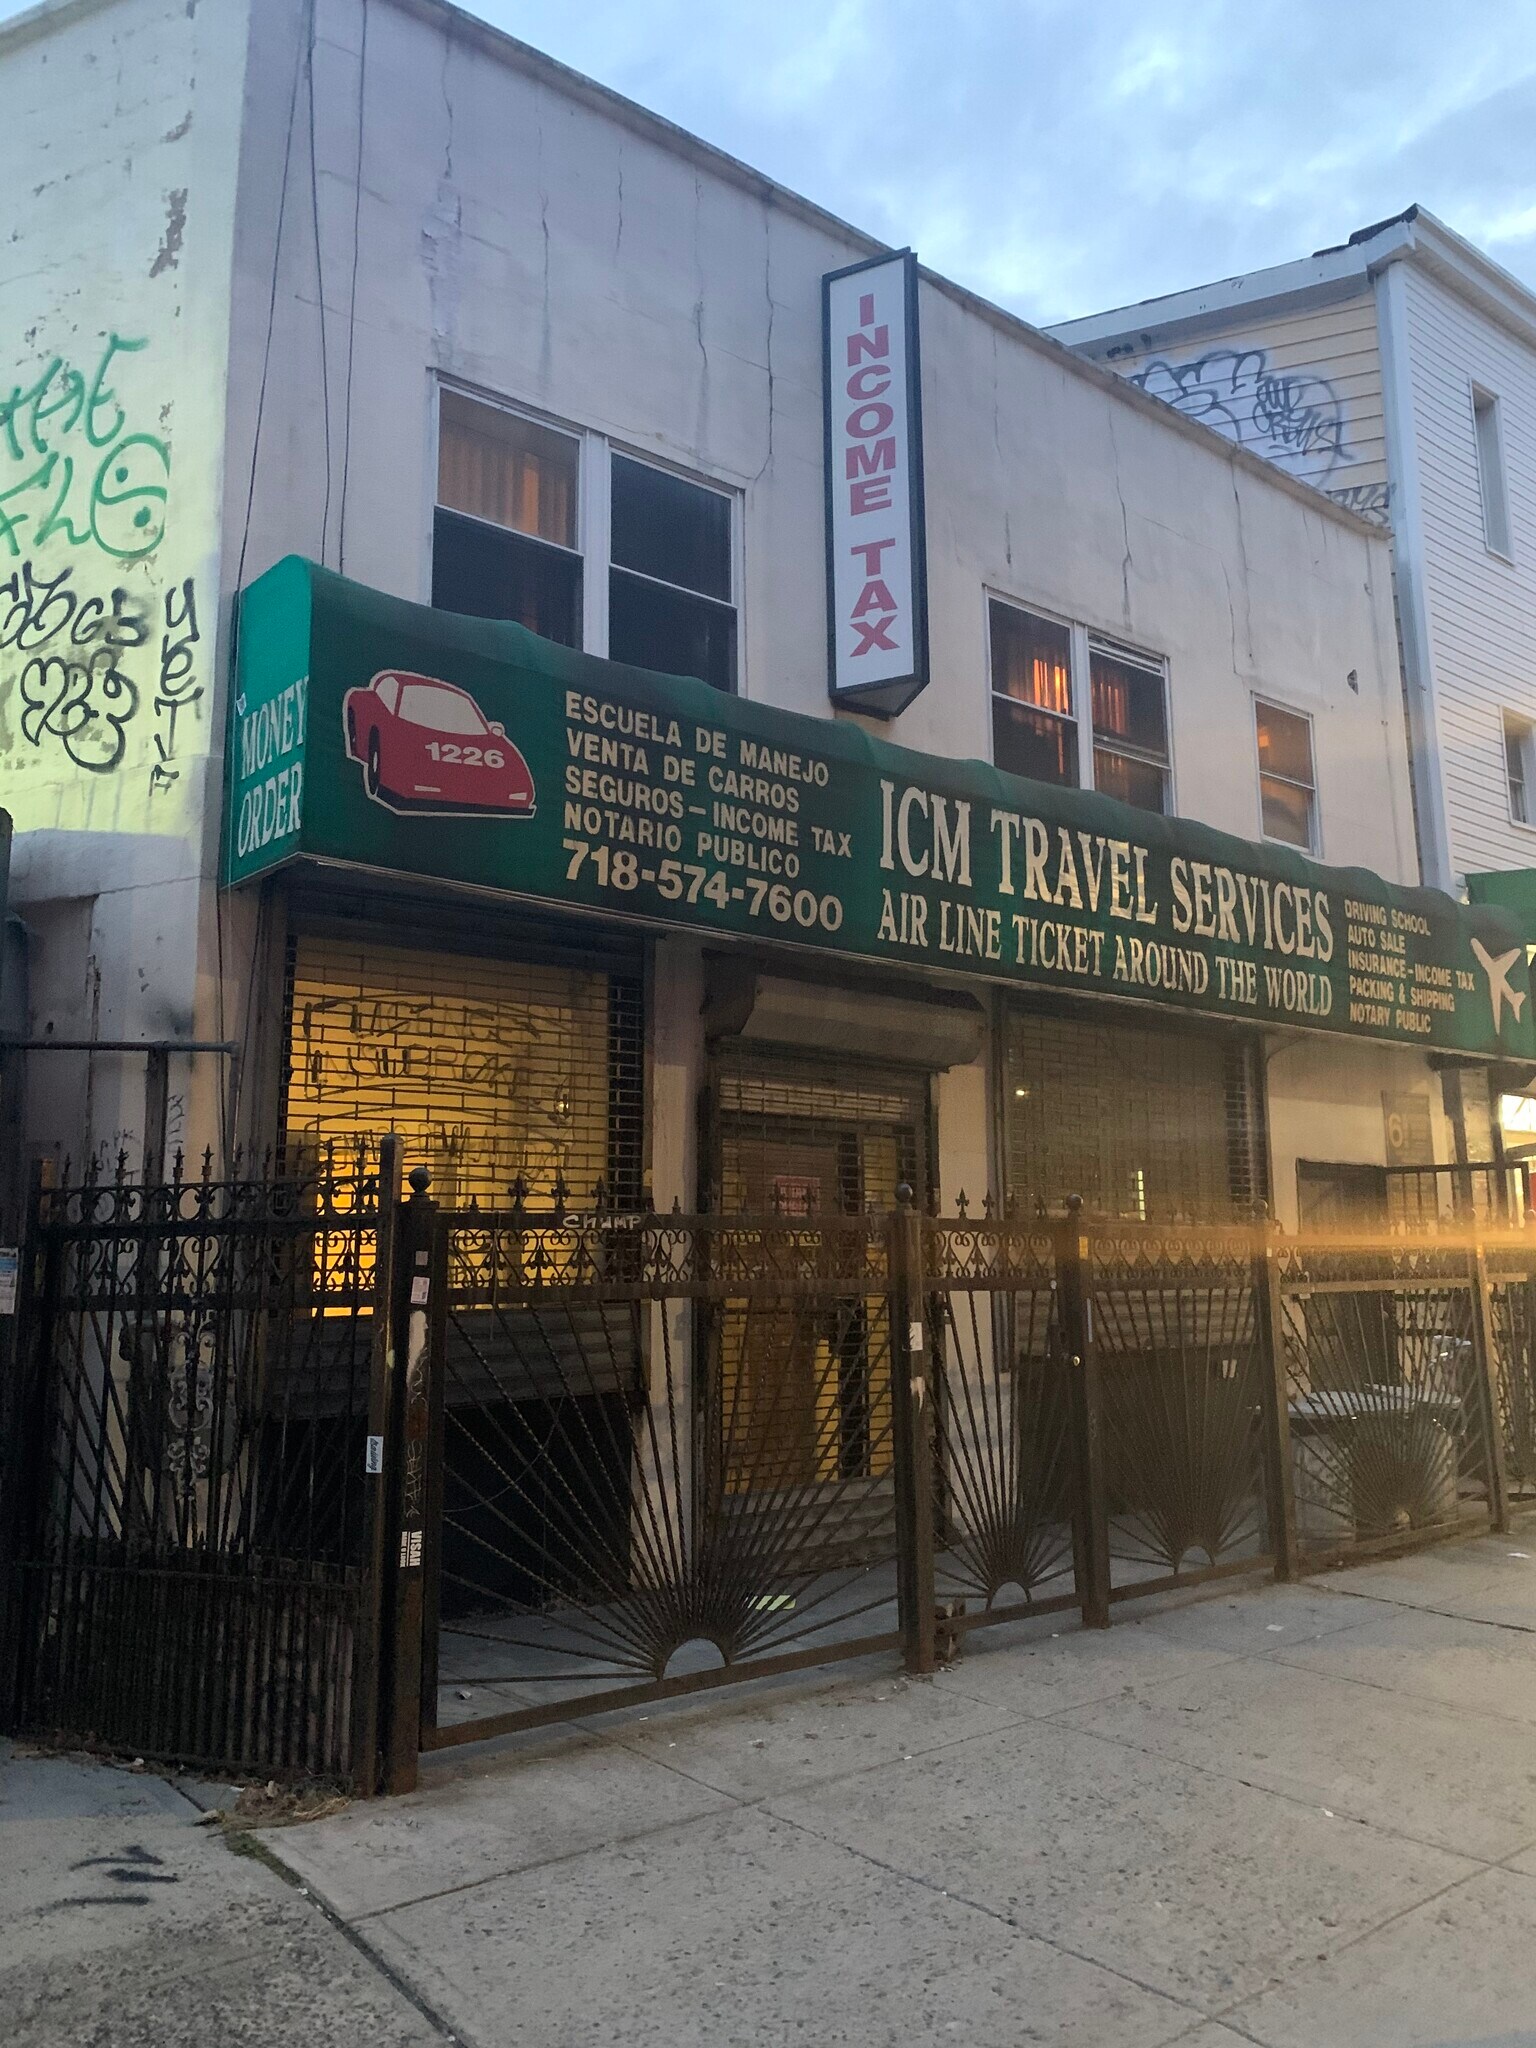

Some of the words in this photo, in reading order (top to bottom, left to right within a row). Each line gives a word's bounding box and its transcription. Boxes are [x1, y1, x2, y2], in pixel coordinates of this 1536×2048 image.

[845, 293, 897, 516] INCOME
[850, 538, 900, 657] TAX
[241, 675, 309, 780] MONEY
[425, 742, 505, 769] 1226
[565, 690, 682, 747] ESCUELA
[695, 727, 727, 758] DE
[740, 740, 829, 787] MANEJO
[566, 727, 649, 775] VENTA
[664, 755, 696, 786] DE
[708, 765, 800, 813] CARROS
[237, 761, 302, 858] ORDER
[564, 800, 682, 852] NOTARIO
[697, 832, 800, 879] PUBLICO
[811, 826, 852, 858] TAX
[562, 838, 844, 932] 718-574-7600
[879, 778, 972, 887] ICM
[990, 808, 1158, 925] TRAVEL
[1170, 856, 1334, 963] SERVICES
[877, 887, 928, 948] AIR
[939, 900, 1001, 960] LINE
[1012, 913, 1105, 977] TICKET
[1112, 934, 1209, 994] AROUND
[1215, 956, 1258, 1005] THE
[1263, 965, 1333, 1016] WORLD
[1344, 899, 1387, 926] DRIVING
[1390, 908, 1431, 936] SCHOOL
[1348, 924, 1376, 948] AUTO
[1380, 930, 1406, 955] SALE
[1349, 975, 1394, 1003] PACKING
[1398, 983, 1406, 1005] &
[1410, 987, 1456, 1012] SHIPPING
[1349, 1002, 1391, 1027] NOTARY
[1395, 1009, 1432, 1033] PUBLIC
[1456, 970, 1475, 991] TAX
